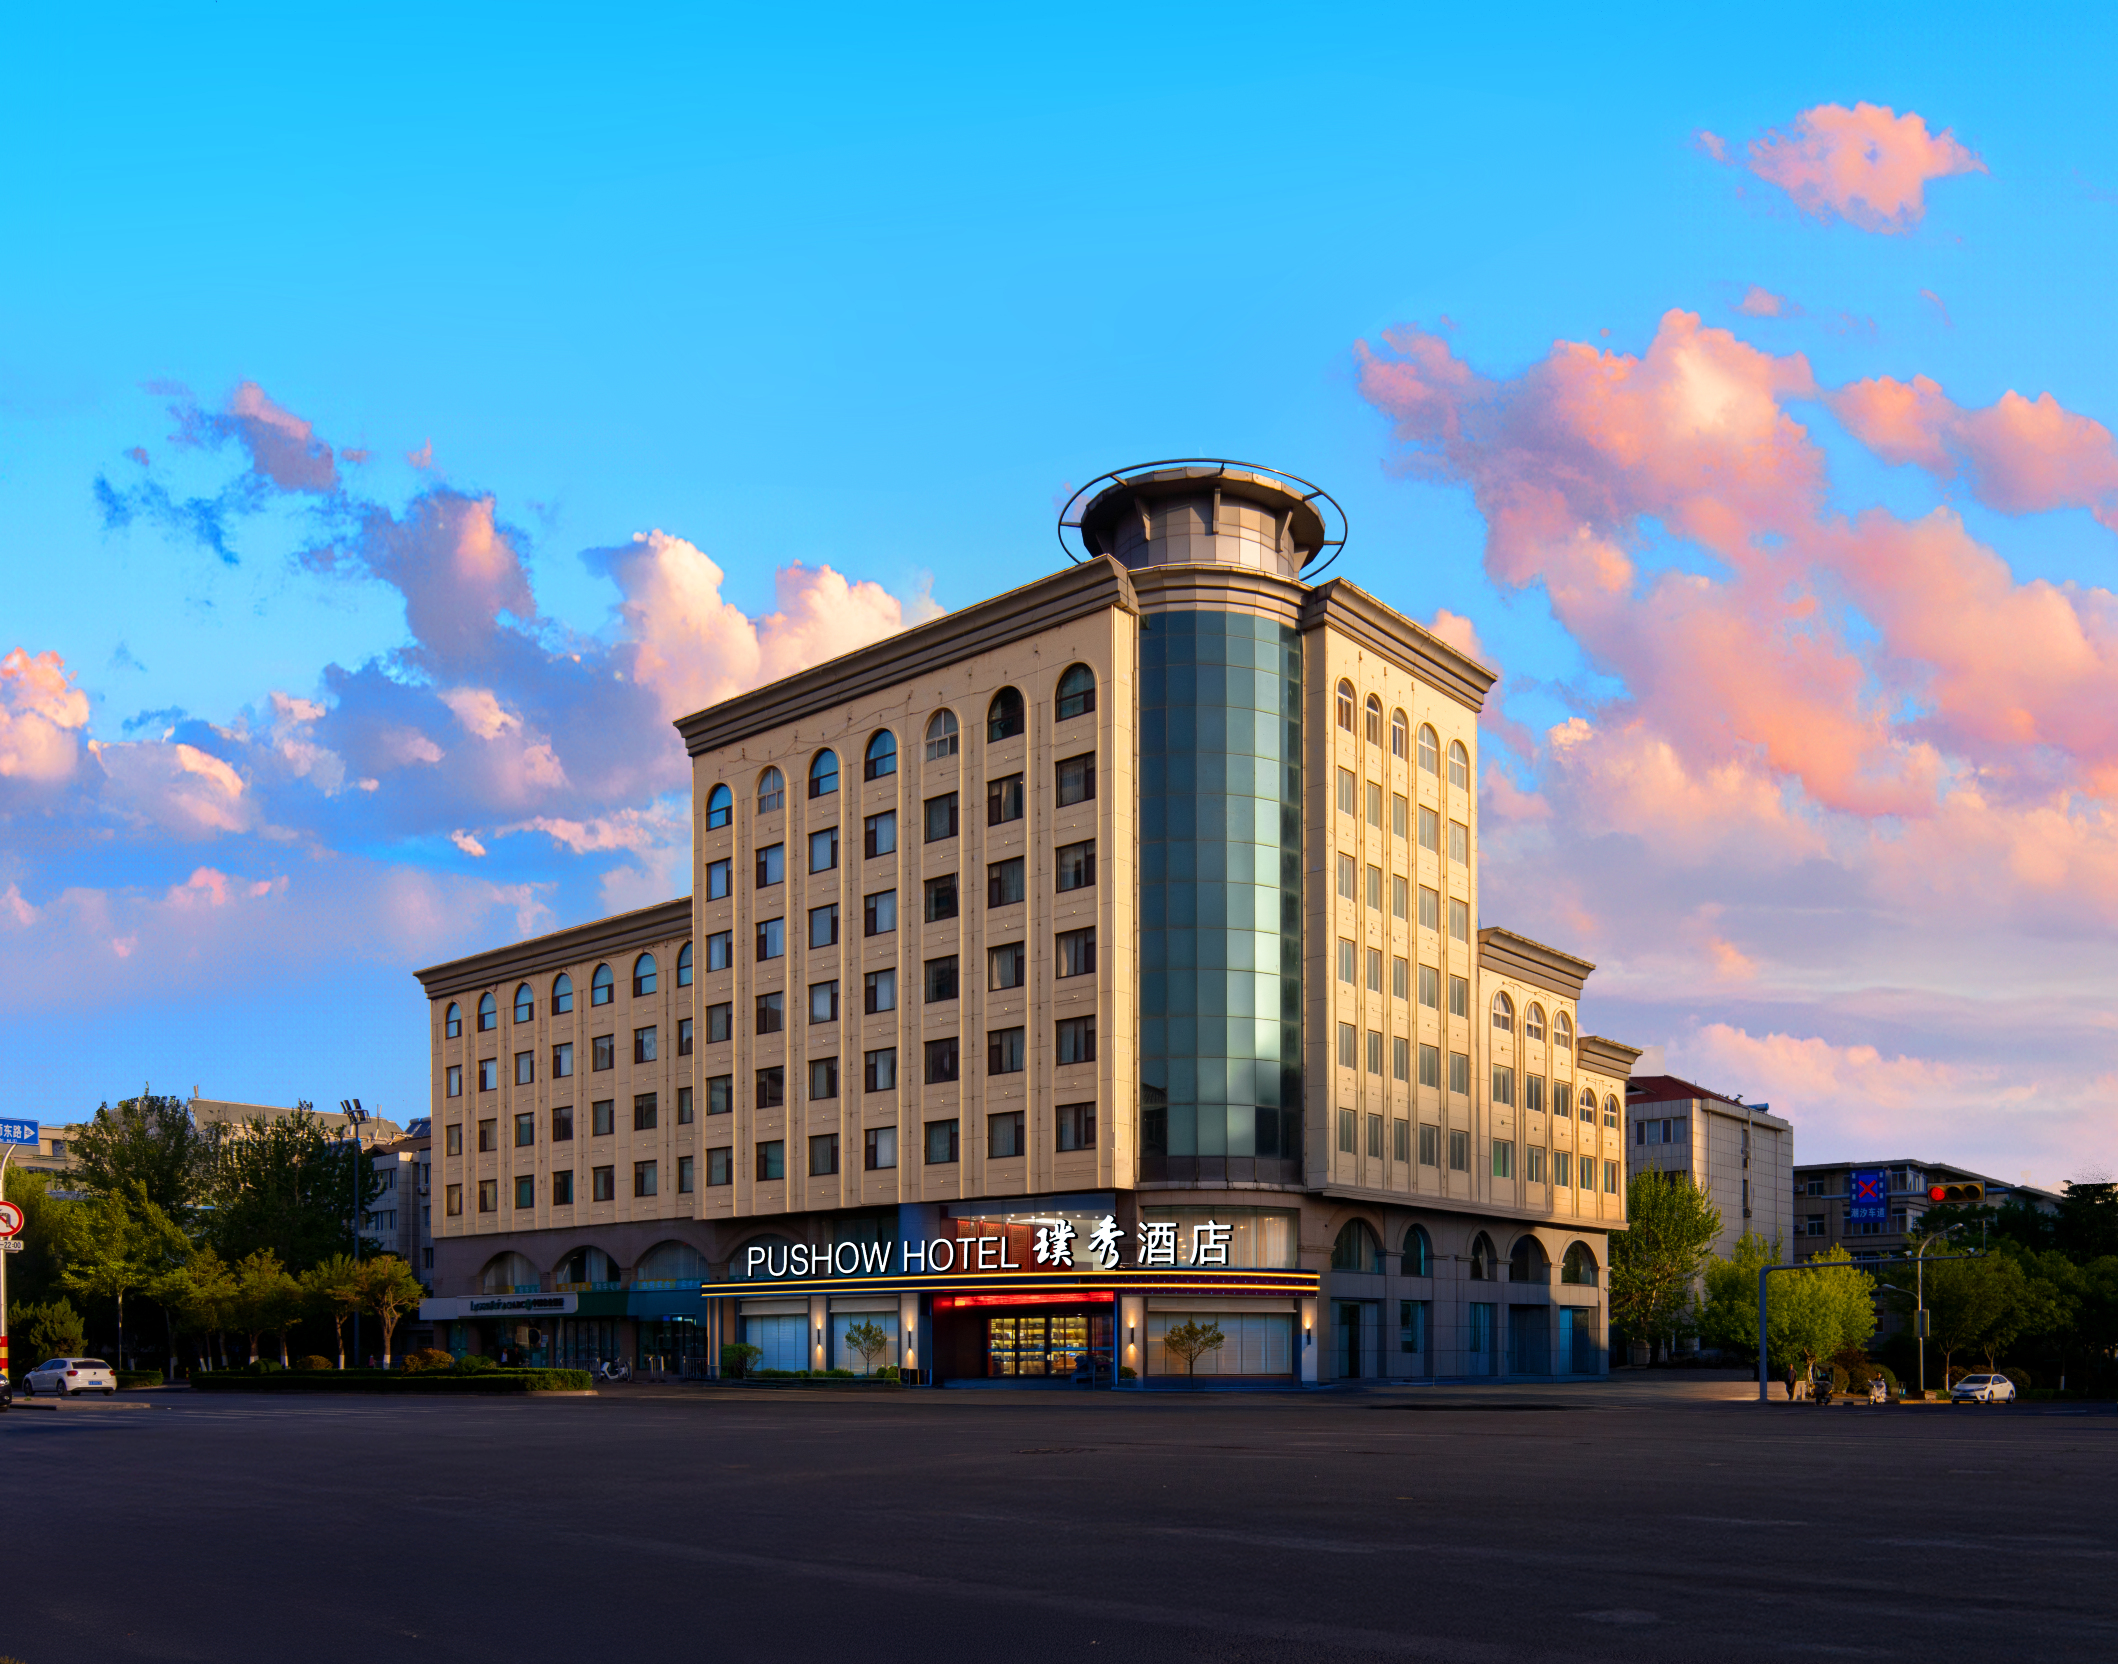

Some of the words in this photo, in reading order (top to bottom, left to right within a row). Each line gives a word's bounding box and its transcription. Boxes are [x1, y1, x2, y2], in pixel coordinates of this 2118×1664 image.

[1850, 1207, 1886, 1218] 潮汐车道
[747, 1241, 892, 1277] PUSHOW
[903, 1236, 1020, 1272] HOTEL
